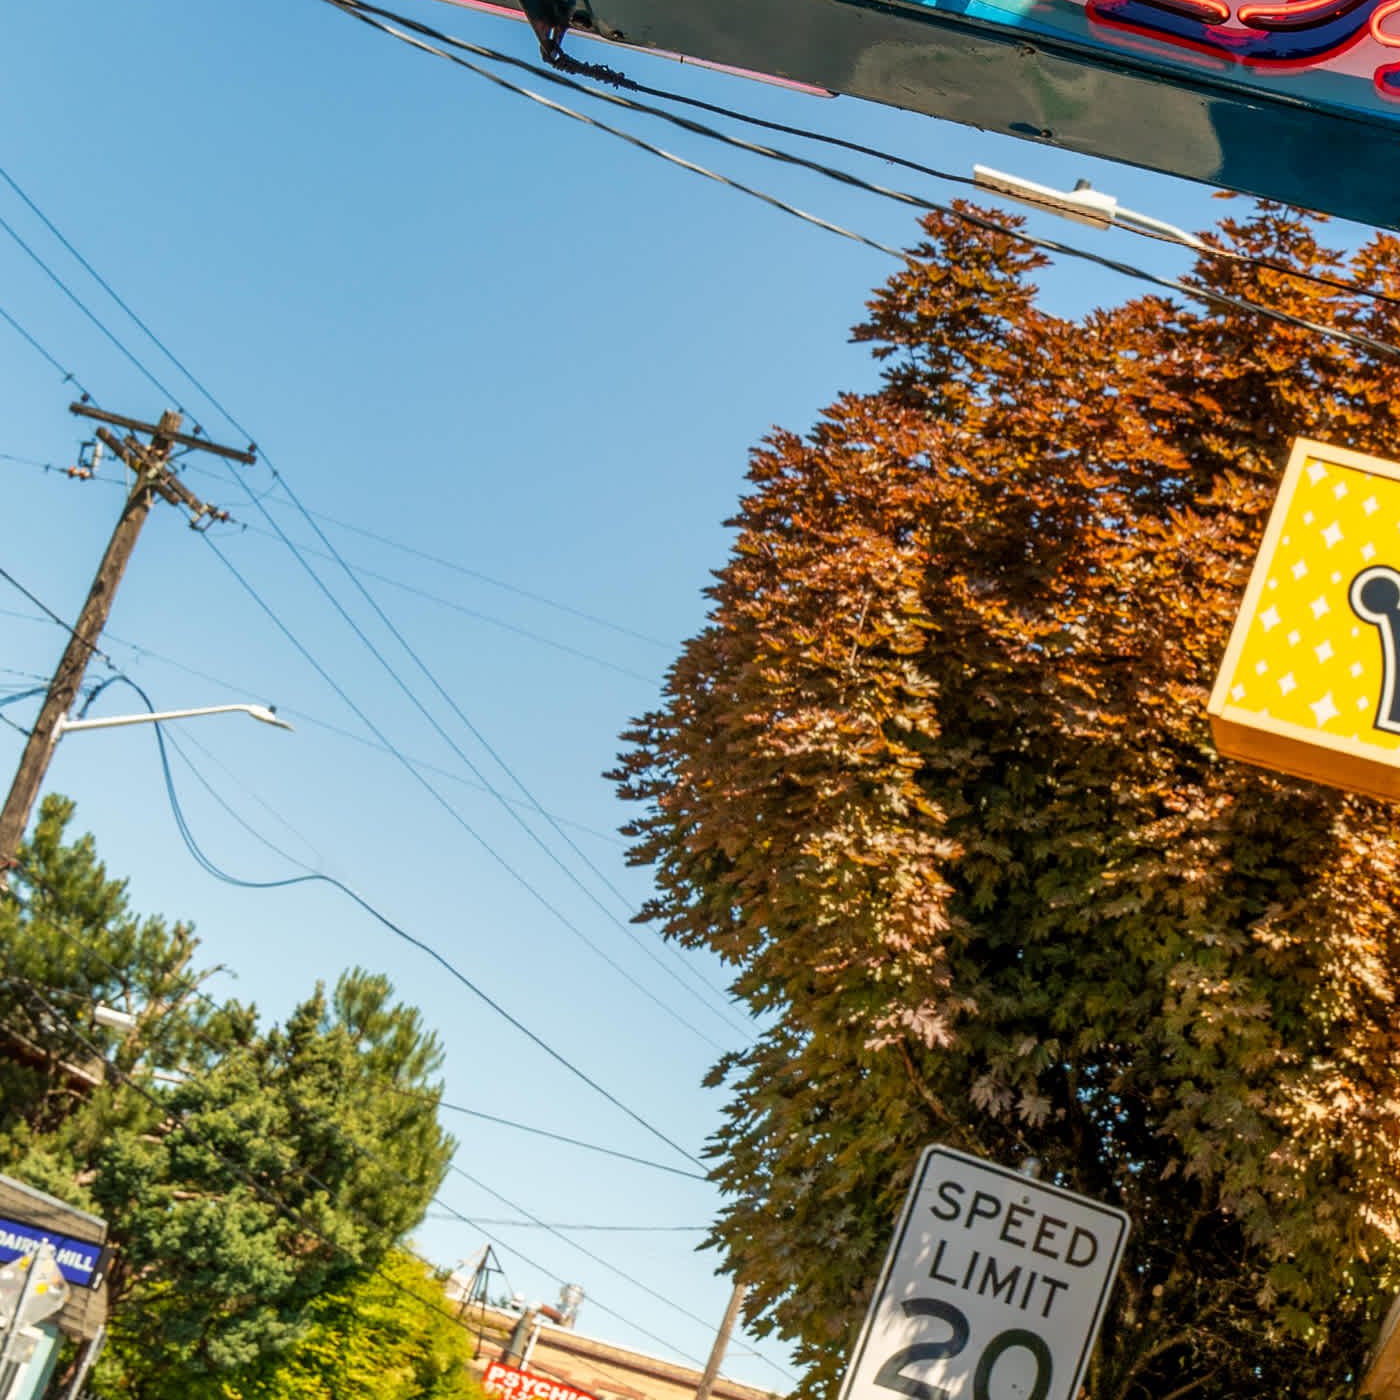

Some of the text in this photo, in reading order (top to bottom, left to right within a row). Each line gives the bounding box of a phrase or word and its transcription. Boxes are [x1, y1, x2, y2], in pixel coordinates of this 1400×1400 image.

[57, 1247, 94, 1273] HILL
[930, 1180, 1098, 1268] SPEED
[928, 1239, 1069, 1318] LIMIT
